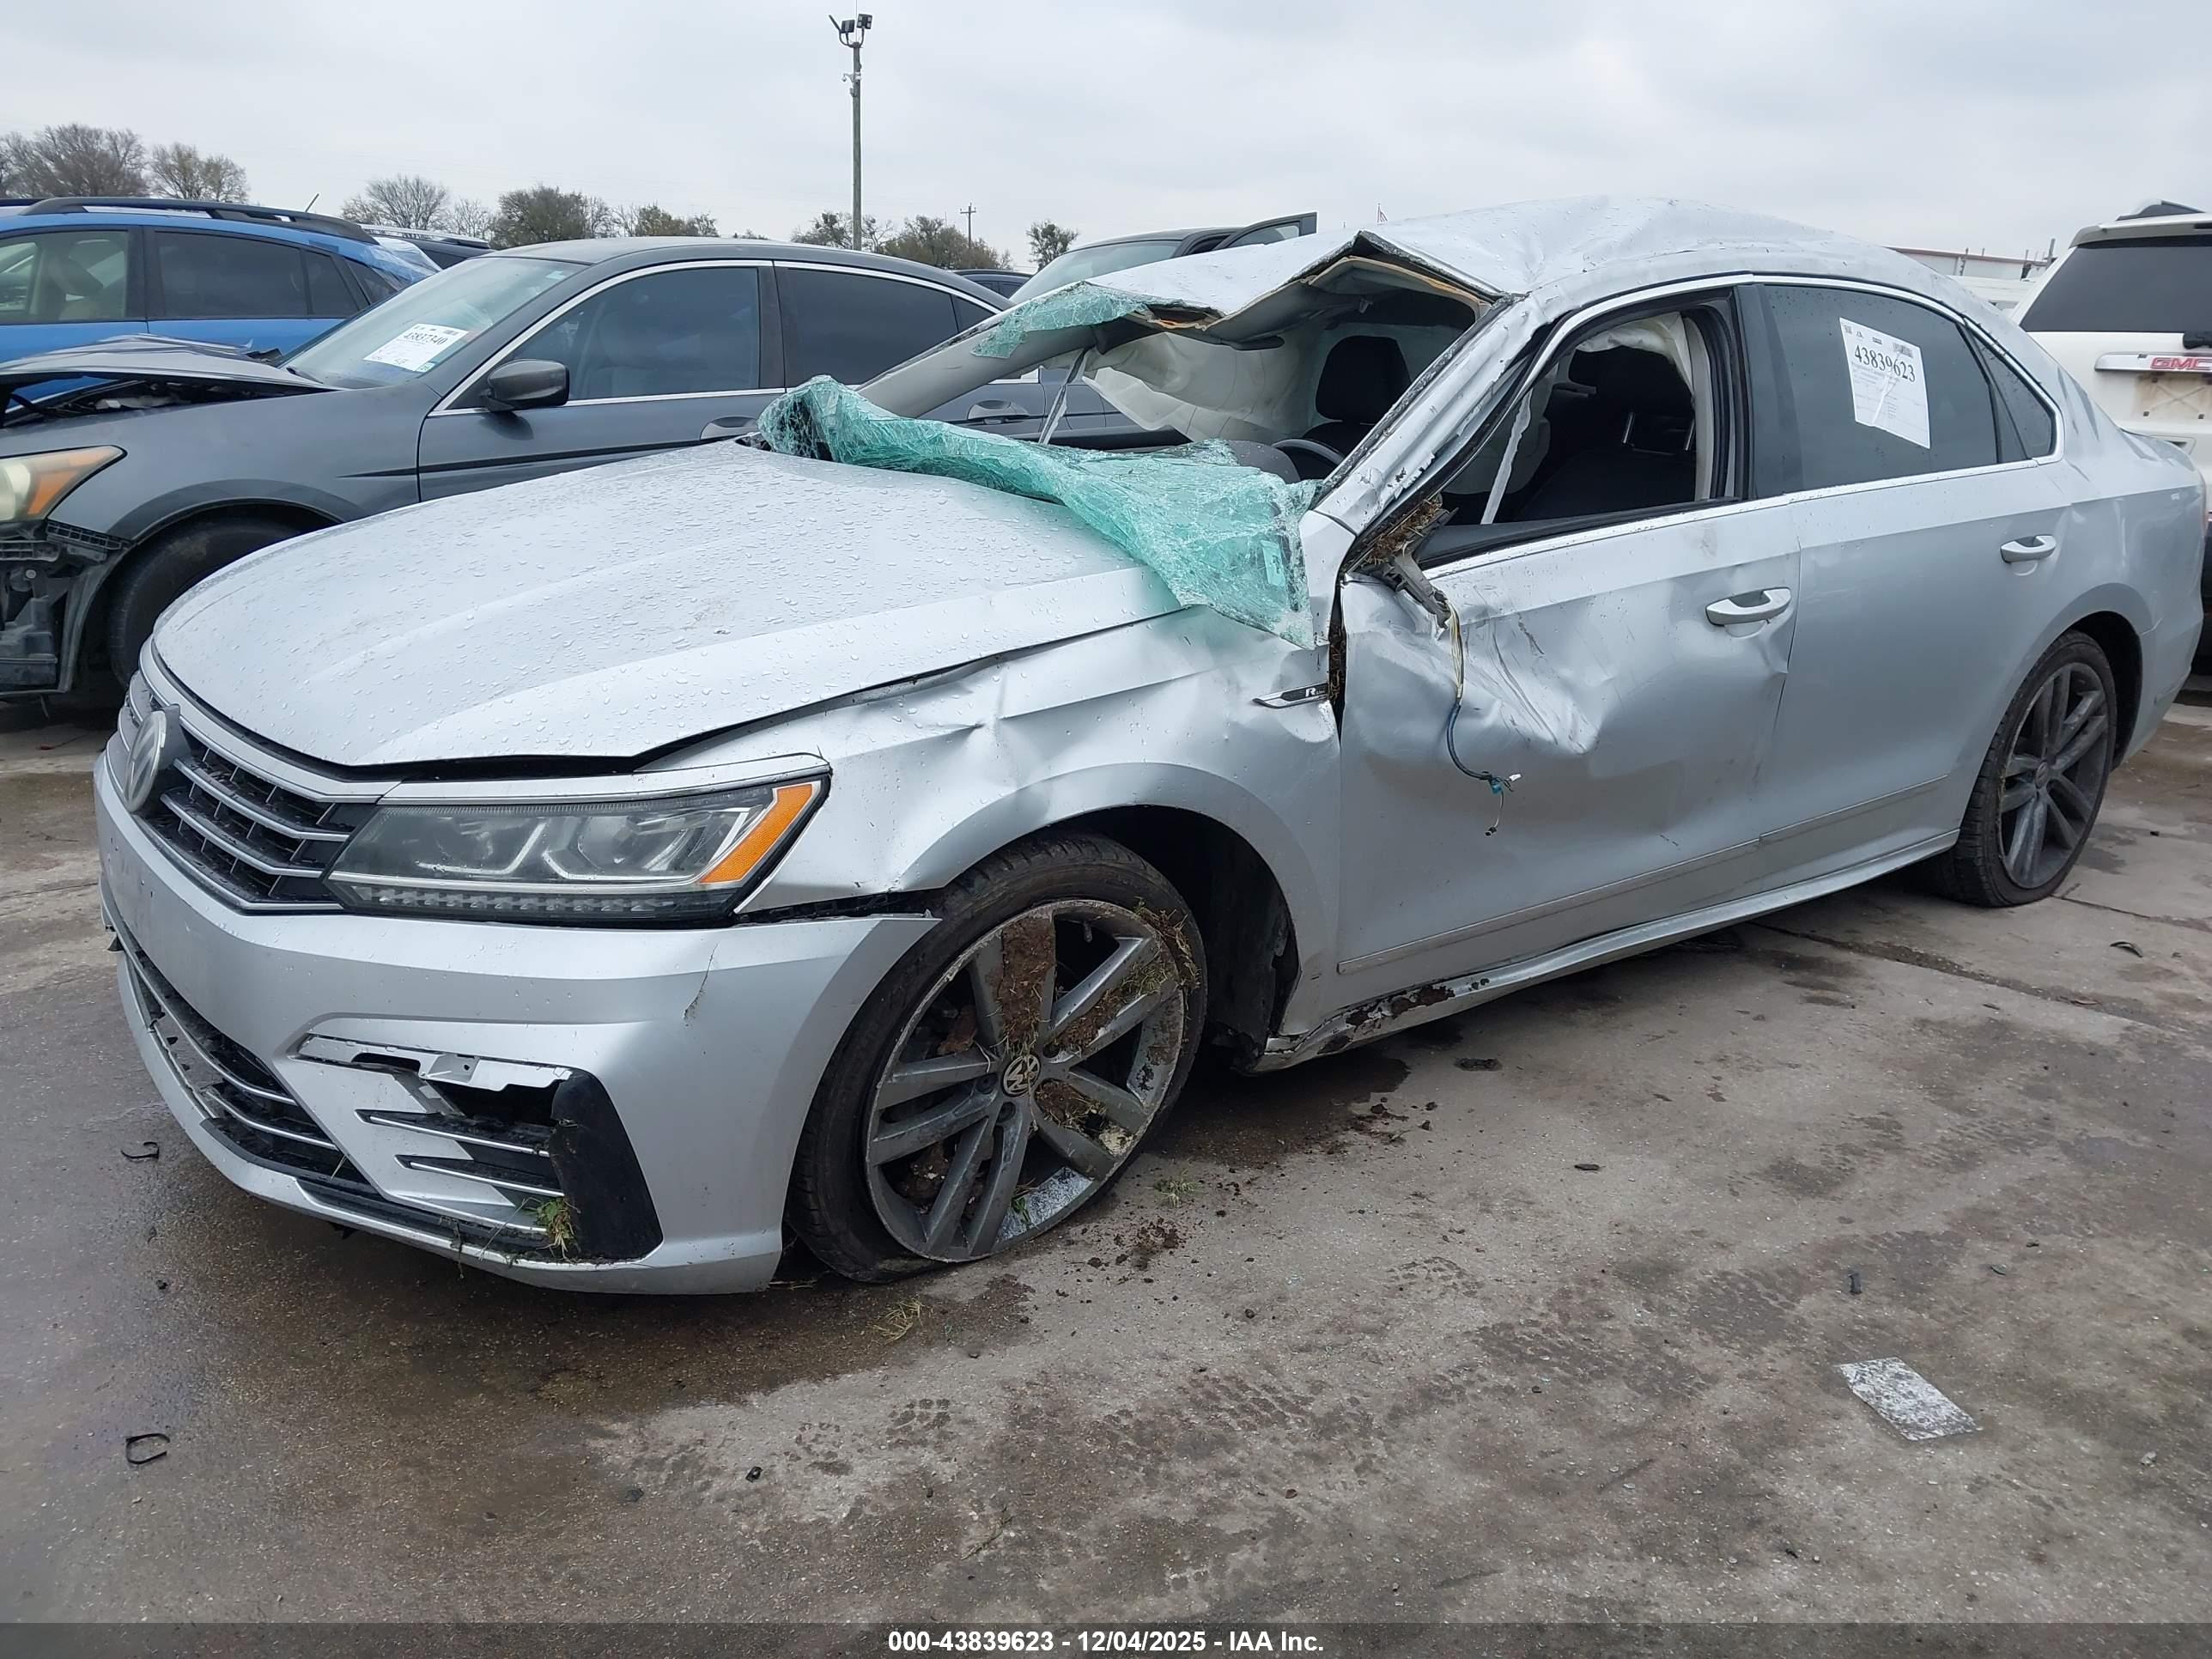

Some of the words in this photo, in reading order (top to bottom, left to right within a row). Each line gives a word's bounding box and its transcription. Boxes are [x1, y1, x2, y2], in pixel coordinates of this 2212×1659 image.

[1854, 344, 1916, 383] 43839623
[2149, 357, 2212, 371] GMC
[1305, 687, 1316, 697] R
